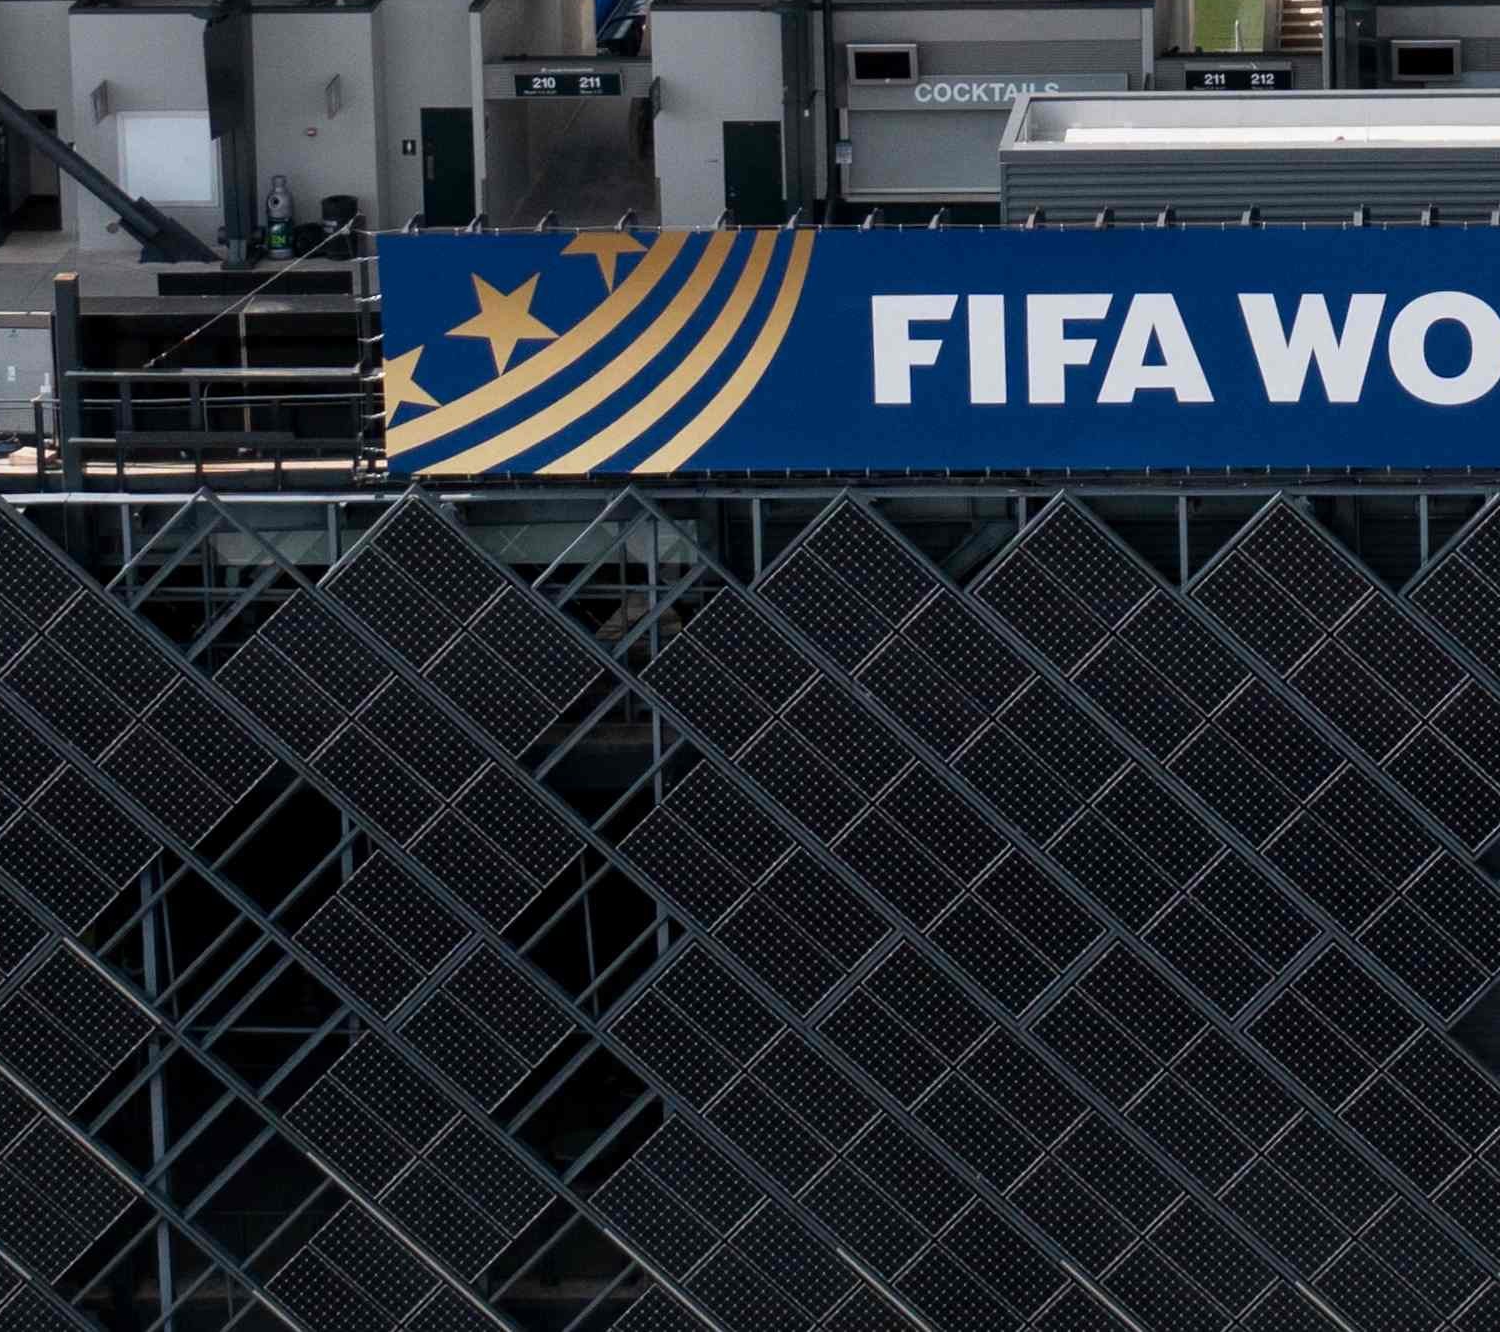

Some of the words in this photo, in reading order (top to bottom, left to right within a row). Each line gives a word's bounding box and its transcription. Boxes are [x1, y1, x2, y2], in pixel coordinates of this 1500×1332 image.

[532, 77, 557, 89] 210
[579, 77, 601, 89] 211
[1203, 73, 1226, 85] 211
[1250, 73, 1275, 85] 212
[871, 293, 1216, 404] FIFA
